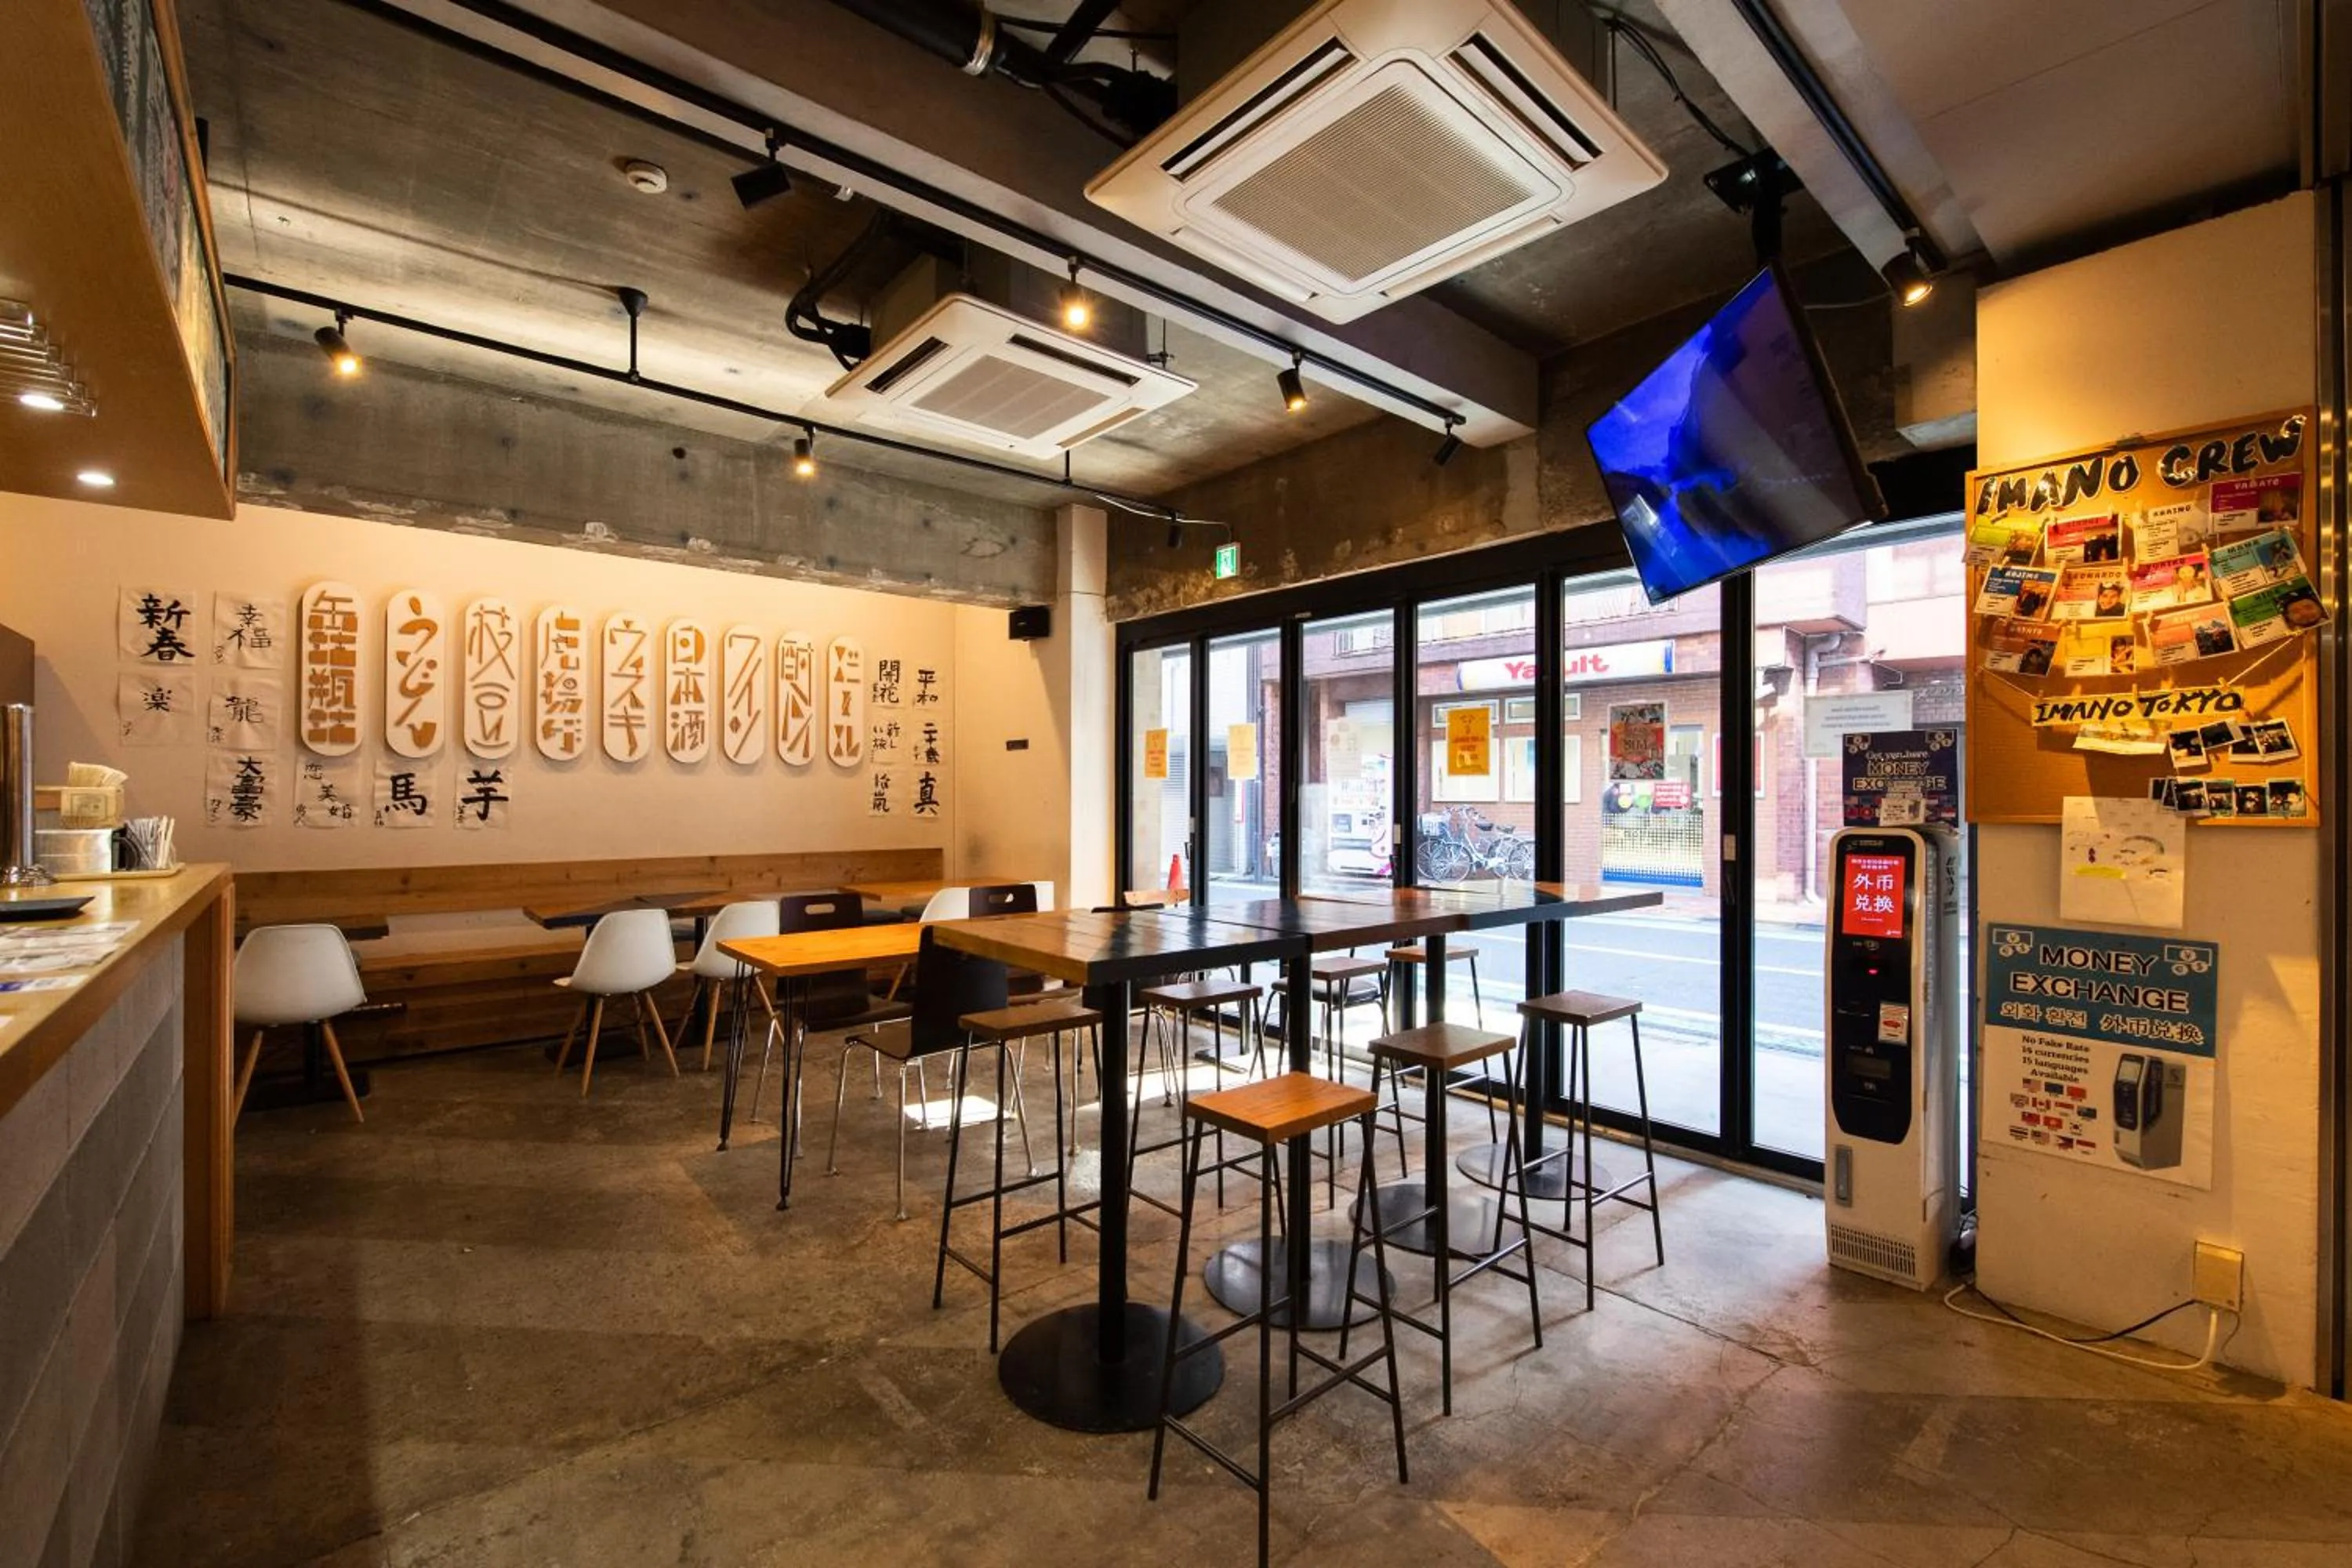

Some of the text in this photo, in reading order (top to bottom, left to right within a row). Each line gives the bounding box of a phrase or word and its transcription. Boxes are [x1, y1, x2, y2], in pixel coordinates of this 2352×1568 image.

[1976, 414, 2307, 514] IMANO CREW
[136, 593, 195, 661] 新春
[227, 603, 272, 650] 幸福
[395, 597, 438, 750] うどん
[879, 659, 900, 703] 開花
[1504, 654, 1609, 680] Yault
[140, 688, 172, 712] 楽
[670, 625, 706, 753] 日本酒
[916, 669, 938, 706] 平和
[2034, 697, 2134, 723] IMANO
[1853, 775, 1947, 791] EXCGE
[1867, 761, 1929, 776] MONEY
[384, 772, 427, 816] 馬
[913, 771, 941, 815] 真
[2039, 944, 2159, 977] MONEY
[2010, 971, 2190, 1014] EXCHANGE
[2022, 1035, 2090, 1053] No Fake Rate
[2034, 1048, 2089, 1063] currencies
[2030, 1068, 2080, 1083] Available
[2034, 1058, 2089, 1075] languages
